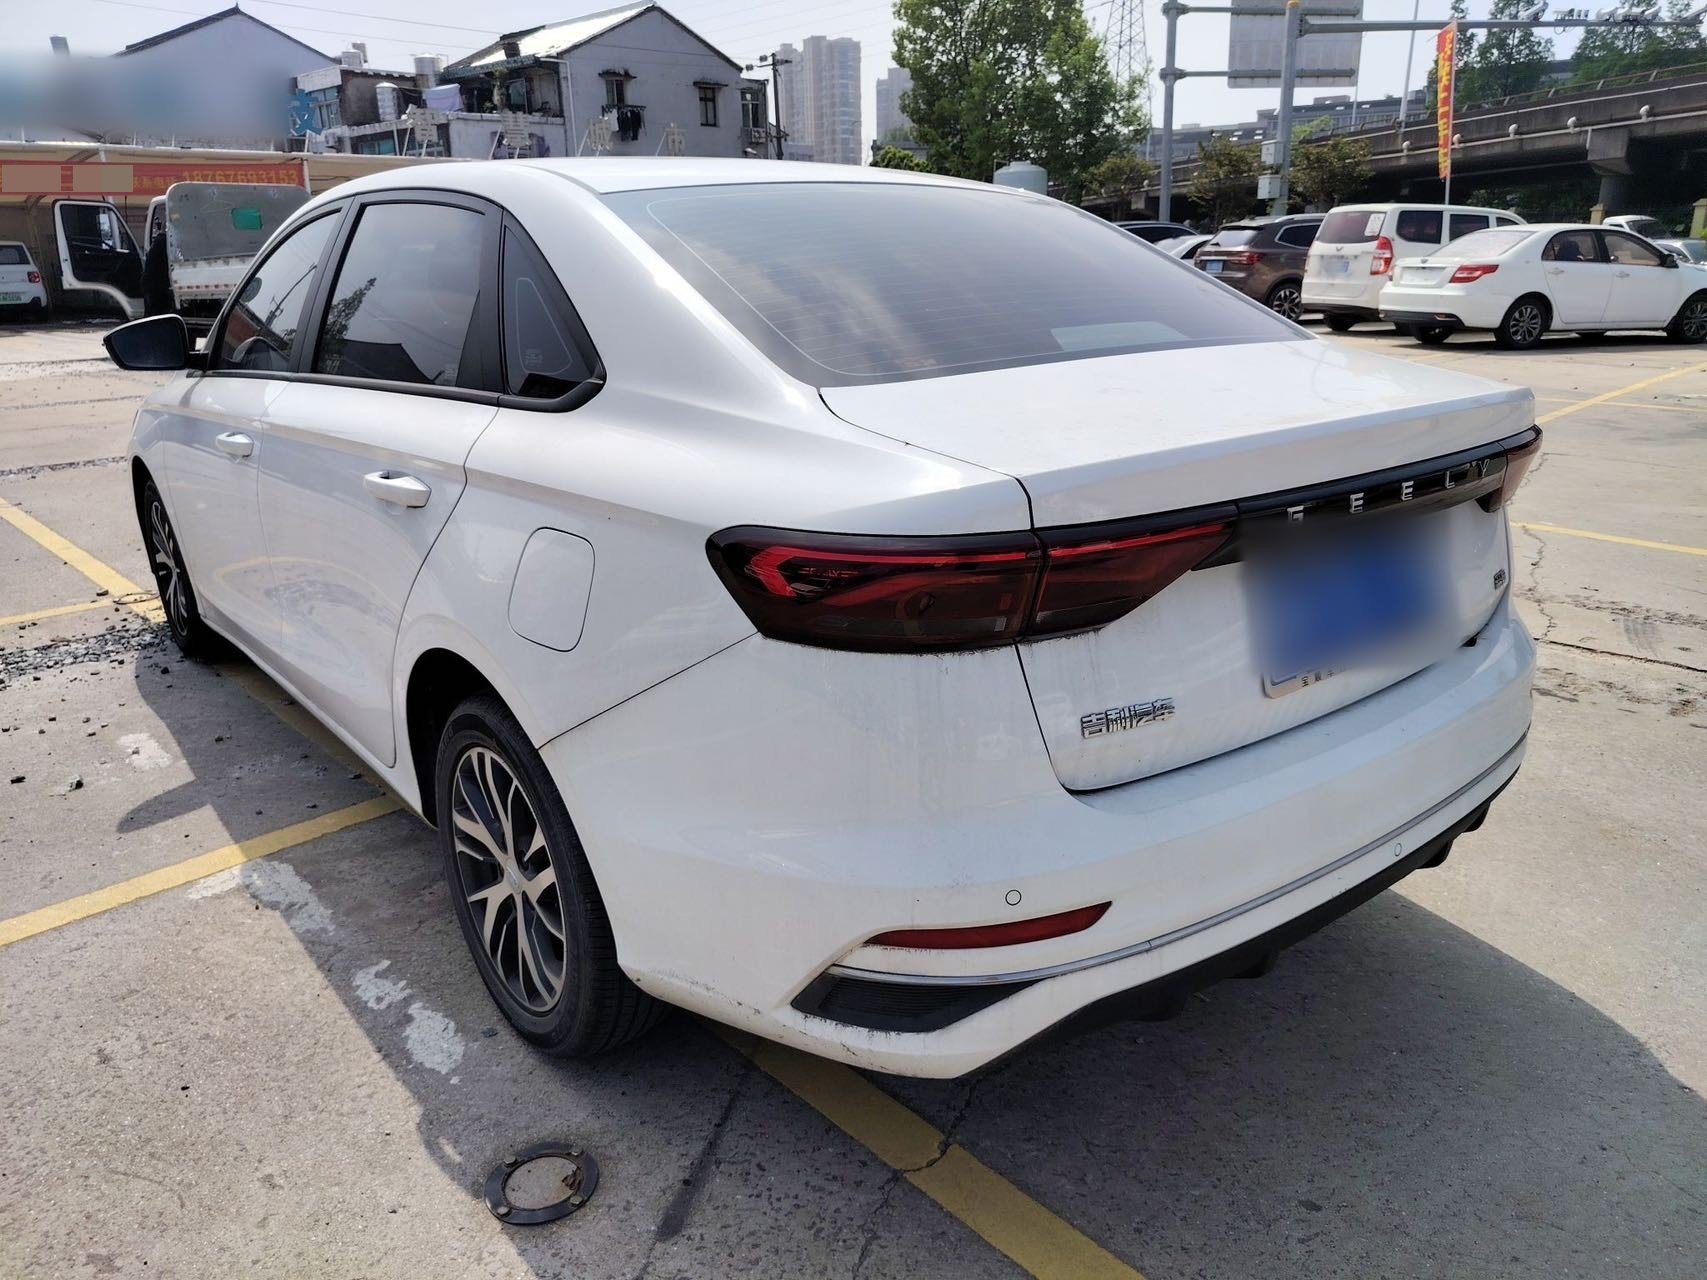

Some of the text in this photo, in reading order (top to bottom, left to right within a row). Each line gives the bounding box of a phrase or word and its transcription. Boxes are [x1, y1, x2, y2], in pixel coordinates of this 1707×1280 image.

[1286, 459, 1491, 523] GEELY
[1080, 697, 1176, 739] 吉利汽车
